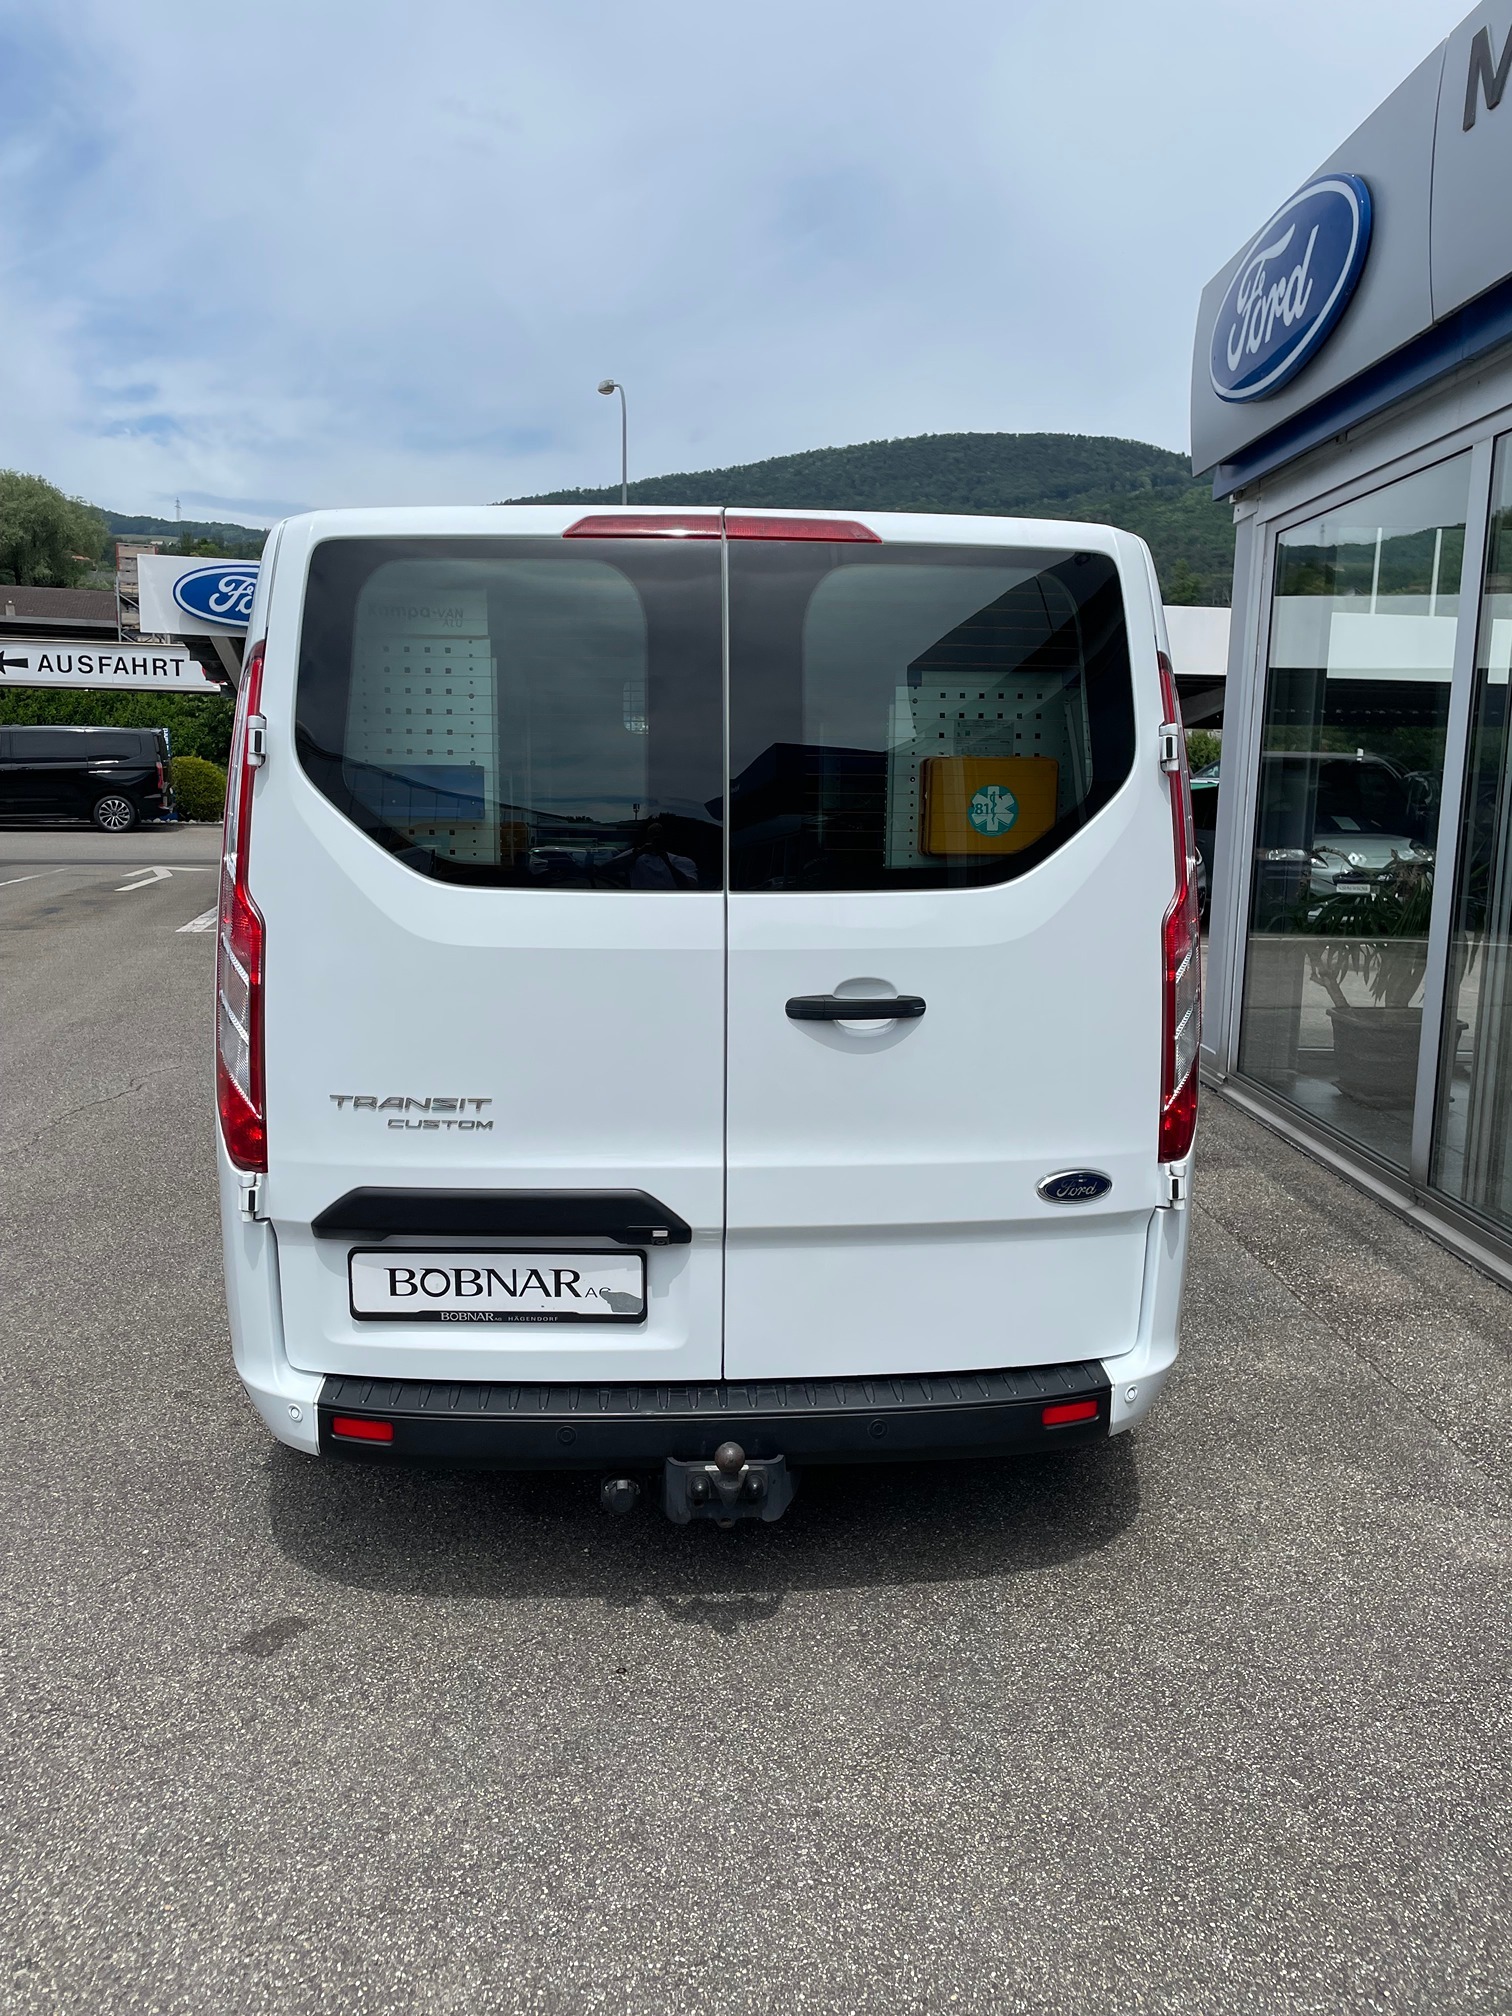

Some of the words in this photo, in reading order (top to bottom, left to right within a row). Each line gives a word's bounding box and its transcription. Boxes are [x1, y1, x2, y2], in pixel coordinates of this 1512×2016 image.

[1227, 223, 1319, 371] Ford
[209, 575, 257, 614] Fo
[37, 654, 185, 677] AUSFAHRT
[329, 1095, 493, 1111] TRANSIT
[388, 1119, 494, 1131] CUSTOM
[1056, 1179, 1098, 1198] Ford
[384, 1268, 582, 1298] BOBNAR
[440, 1312, 494, 1321] BOBNAR
